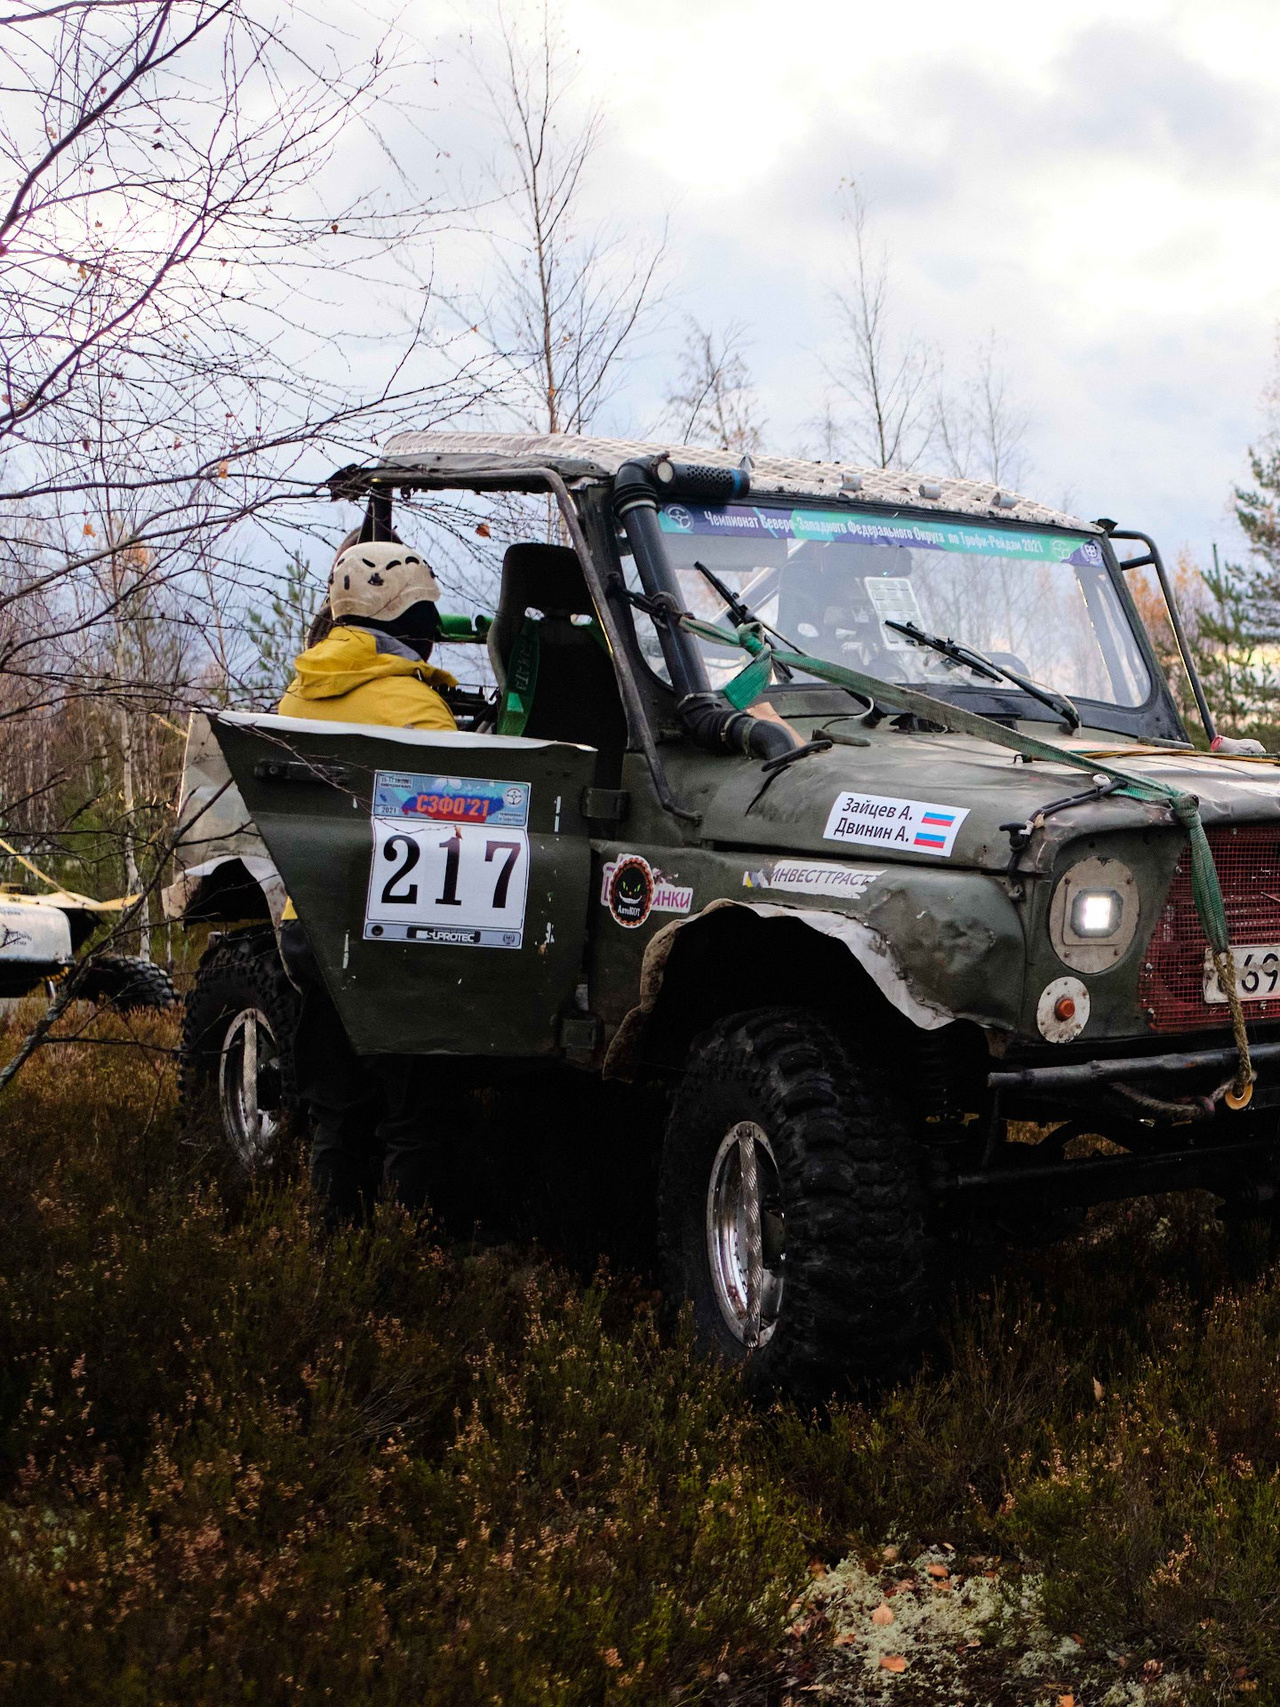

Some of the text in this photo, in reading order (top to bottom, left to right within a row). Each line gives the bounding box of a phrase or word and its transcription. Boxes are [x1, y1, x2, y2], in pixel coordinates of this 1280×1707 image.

[704, 510, 759, 529] Чемпионат
[759, 513, 847, 534] Северо-Западного
[847, 520, 913, 540] Федерального
[913, 527, 945, 544] Округа
[947, 534, 959, 544] по
[1022, 538, 1044, 553] 2021
[416, 794, 490, 817] СЗФО'21
[842, 797, 913, 821] Зайцев А.
[833, 817, 910, 842] Двинин А.
[381, 834, 521, 909] 217
[426, 929, 476, 943] SUPROTEC
